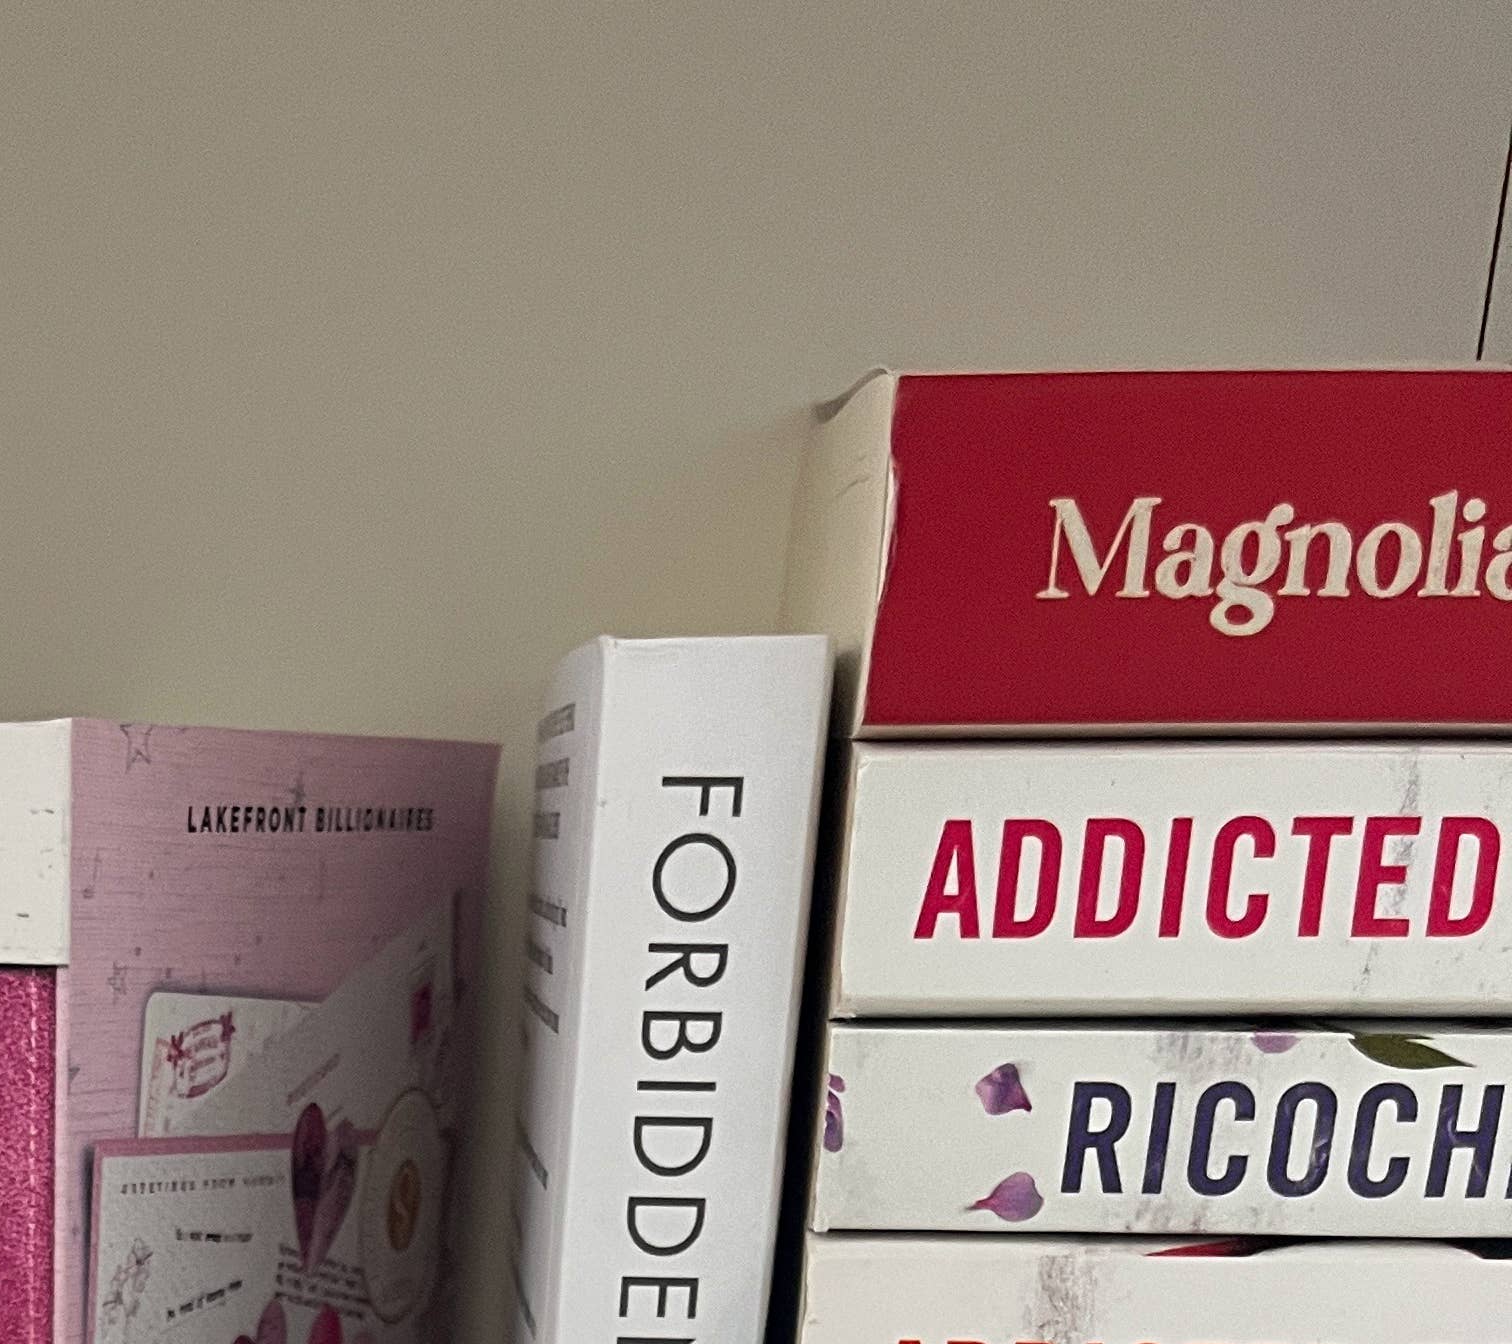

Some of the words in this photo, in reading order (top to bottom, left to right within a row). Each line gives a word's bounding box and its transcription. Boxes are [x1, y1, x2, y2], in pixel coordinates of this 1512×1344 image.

[187, 805, 308, 834] LAKEFRONT
[315, 806, 434, 832] BILLIONAIRES
[913, 816, 1501, 940] ADDICTED
[1060, 1080, 1512, 1199] RICOCH
